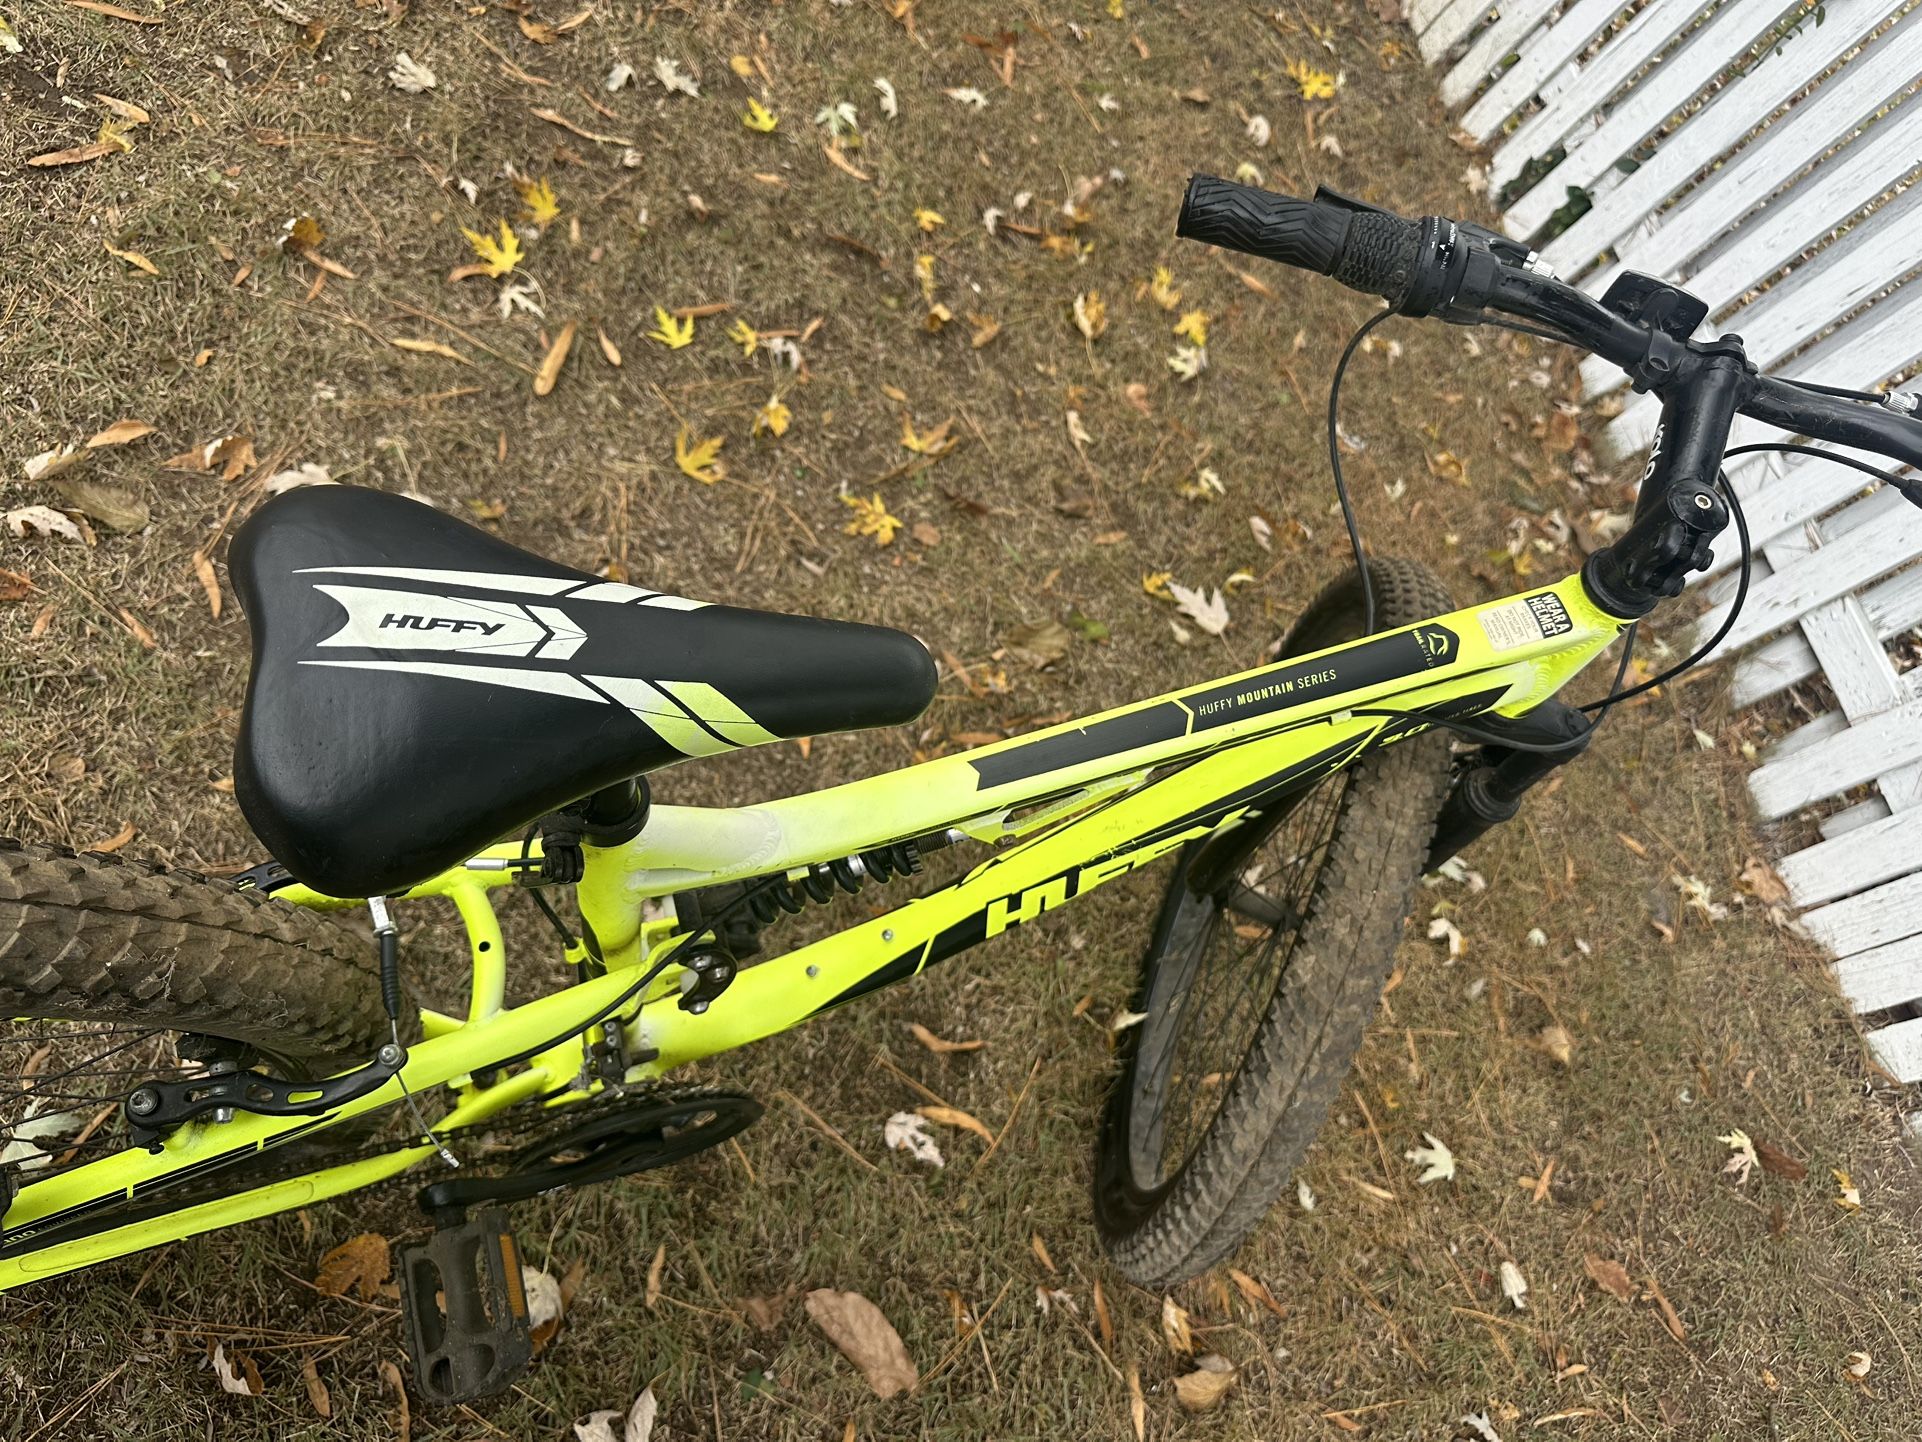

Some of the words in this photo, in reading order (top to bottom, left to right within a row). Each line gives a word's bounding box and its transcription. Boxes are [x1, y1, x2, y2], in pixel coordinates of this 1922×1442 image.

[378, 613, 506, 636] HUFFY
[1527, 597, 1558, 635] HELMET
[1541, 593, 1567, 623] WEAR
[1557, 623, 1571, 633] A
[1199, 698, 1232, 716] HUFFY
[1237, 681, 1294, 706] MOUNTAIN
[1297, 669, 1337, 689] SERIES
